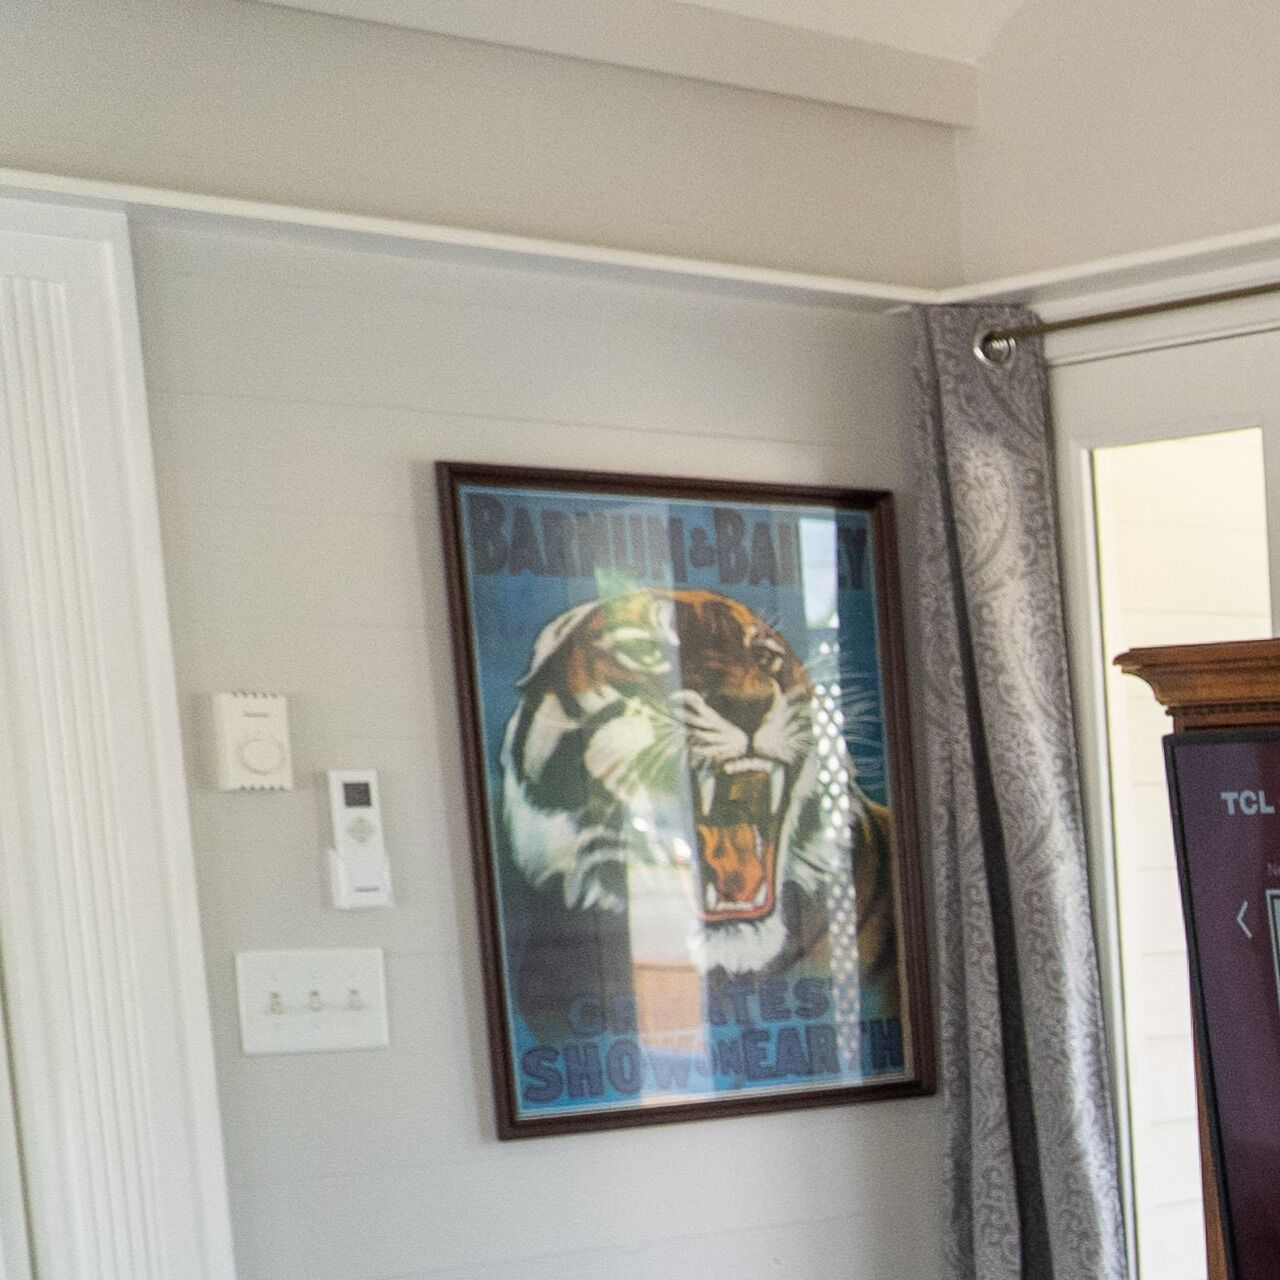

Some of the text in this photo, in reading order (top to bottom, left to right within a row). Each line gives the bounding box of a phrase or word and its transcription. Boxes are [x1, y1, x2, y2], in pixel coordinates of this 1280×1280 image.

[714, 506, 868, 590] BAIY
[1220, 789, 1275, 815] TCL
[741, 1017, 902, 1081] EARH
